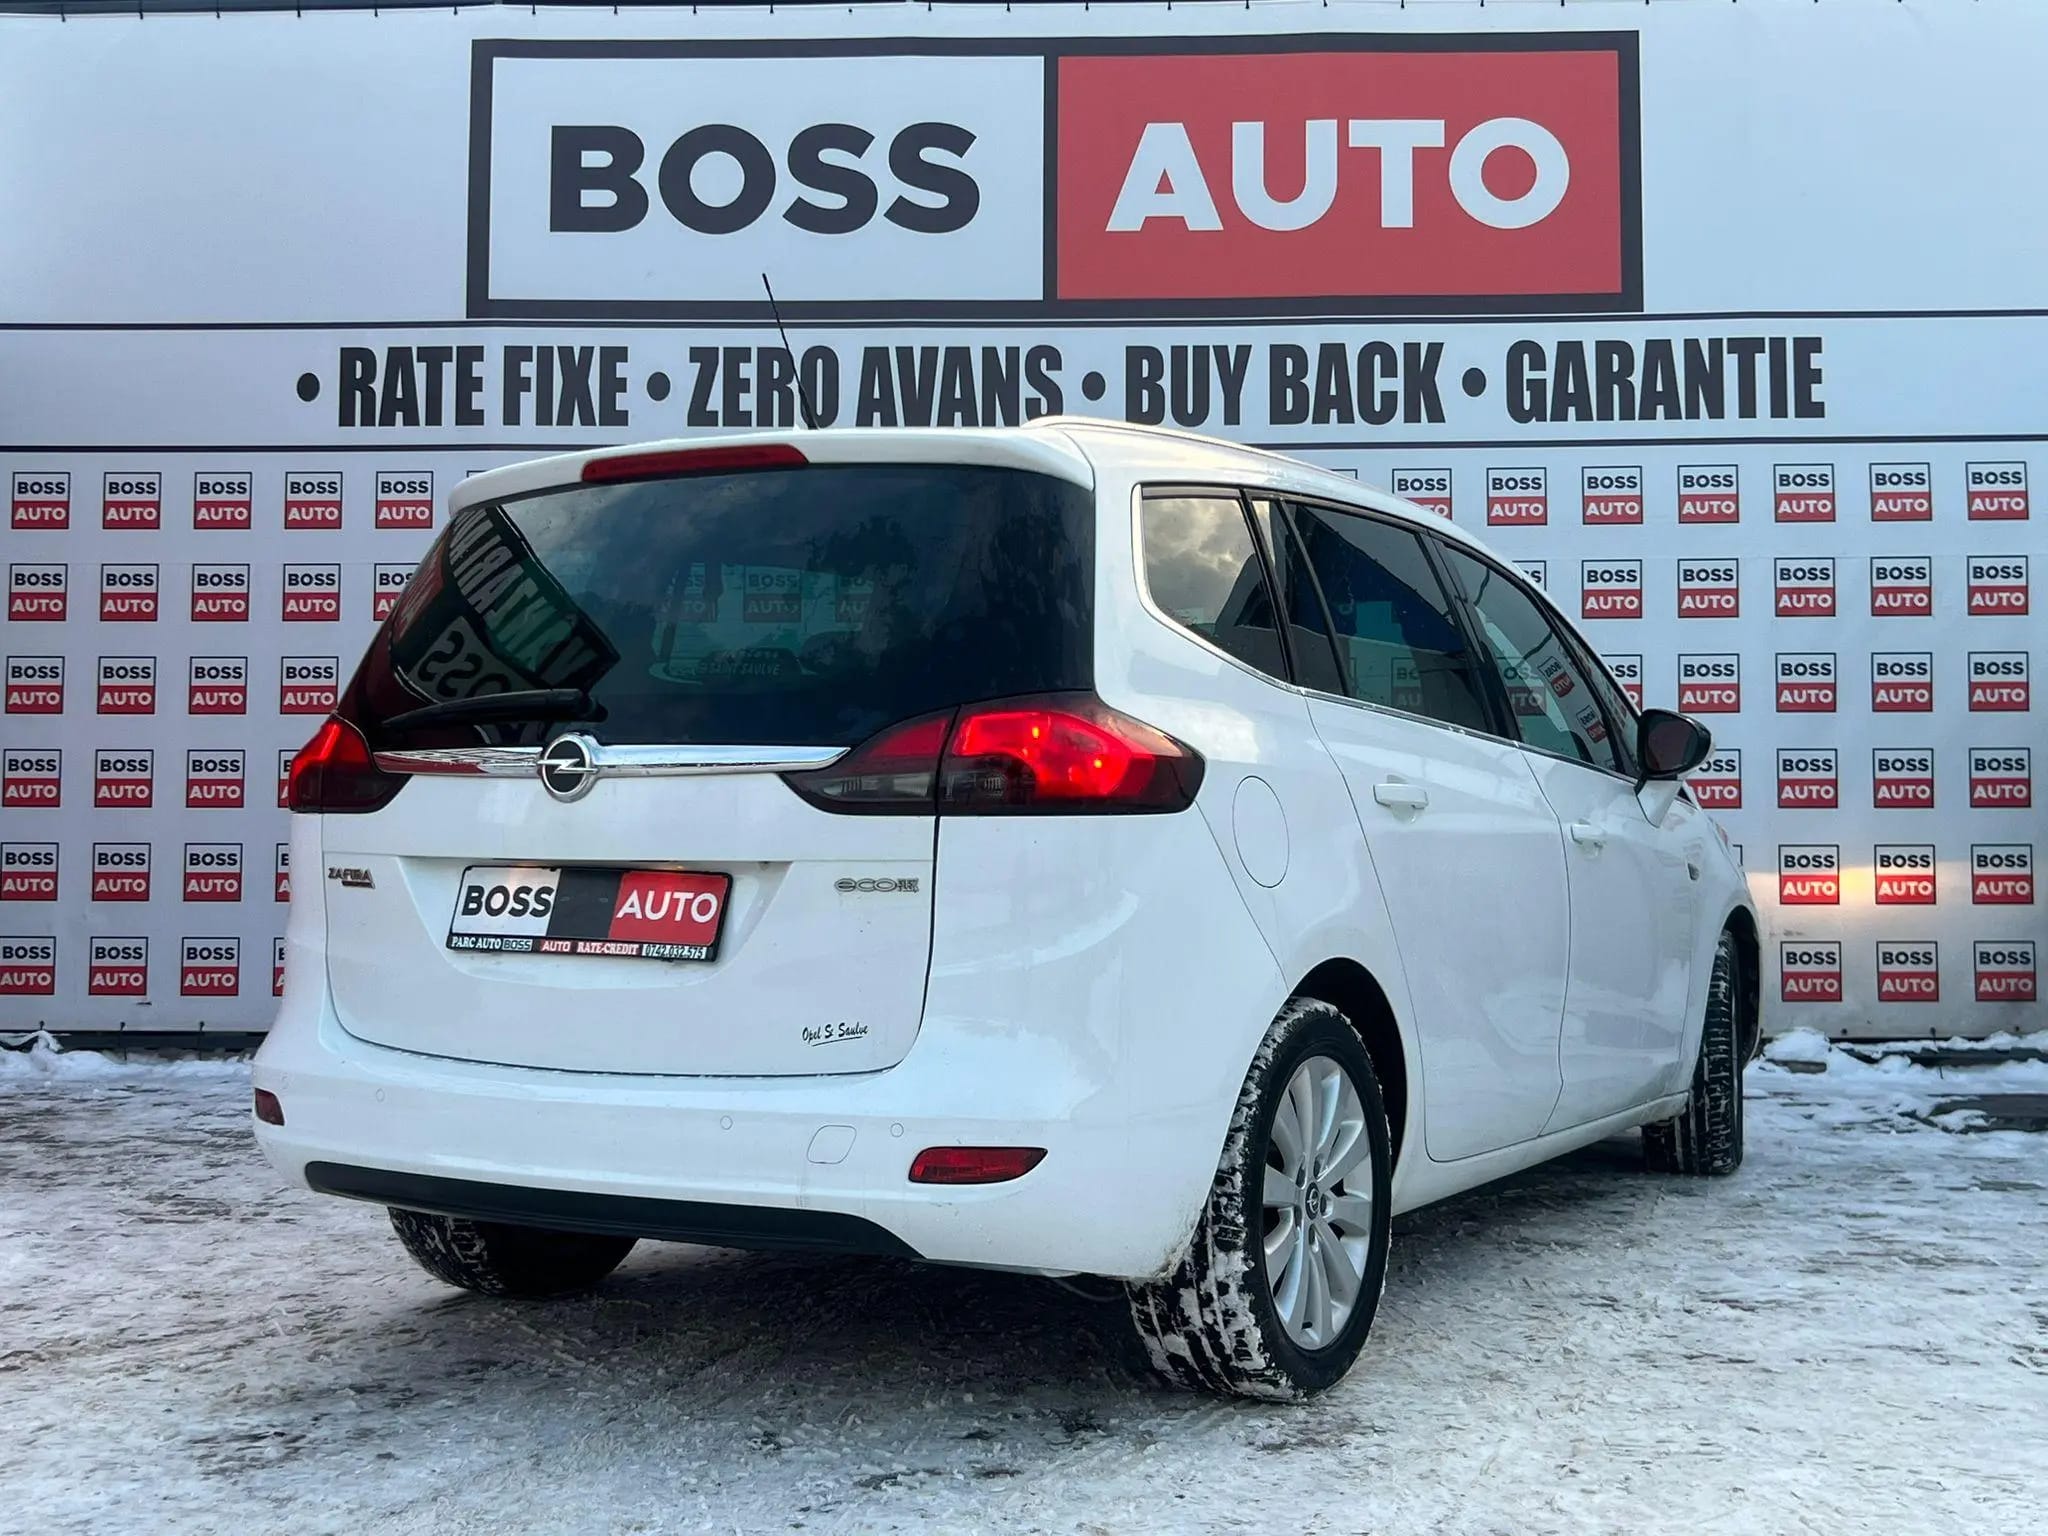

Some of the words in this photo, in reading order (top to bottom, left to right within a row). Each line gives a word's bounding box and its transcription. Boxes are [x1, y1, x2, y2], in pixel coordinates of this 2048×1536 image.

[551, 122, 979, 235] BOSS
[1106, 117, 1570, 232] AUTO
[338, 346, 484, 427] RATE
[503, 346, 628, 427] FIXE
[687, 345, 839, 428] ZERO
[856, 345, 1064, 427] AVANS
[1125, 344, 1252, 427] BUY
[1269, 341, 1445, 425] BACK
[1506, 337, 1825, 424] GARANTIE
[1396, 477, 1448, 492] BOSS
[1491, 476, 1543, 490] BOSS
[1587, 475, 1639, 489] BOSS
[1683, 474, 1734, 488] BOSS
[1779, 473, 1830, 487] BOSS
[1875, 472, 1926, 485] BOSS
[1971, 471, 2023, 484] BOSS
[17, 481, 65, 494] BOSS
[108, 481, 155, 494] BOSS
[199, 481, 246, 494] BOSS
[290, 481, 337, 494] BOSS
[380, 480, 428, 493] BOSS
[1490, 504, 1543, 518] AUTO
[1586, 502, 1639, 516] AUTO
[1682, 501, 1736, 515] AUTO
[1779, 500, 1832, 514] AUTO
[1874, 499, 1928, 513] AUTO
[1971, 497, 2024, 512] AUTO
[15, 507, 66, 521] AUTO
[106, 507, 157, 521] AUTO
[197, 507, 248, 521] AUTO
[288, 506, 339, 521] AUTO
[378, 506, 430, 520] AUTO
[14, 572, 62, 586] BOSS
[106, 573, 153, 586] BOSS
[197, 573, 245, 586] BOSS
[287, 573, 335, 586] BOSS
[1587, 569, 1638, 583] BOSS
[1683, 568, 1734, 582] BOSS
[1779, 567, 1831, 581] BOSS
[1876, 567, 1927, 580] BOSS
[1973, 566, 2024, 579] BOSS
[749, 574, 798, 587] BOSS
[12, 598, 63, 612] AUTO
[104, 599, 155, 613] AUTO
[194, 599, 246, 613] AUTO
[286, 598, 337, 613] AUTO
[1587, 596, 1639, 610] AUTO
[1683, 595, 1736, 609] AUTO
[1779, 594, 1833, 608] AUTO
[1876, 593, 1929, 607] AUTO
[1973, 592, 2026, 607] AUTO
[11, 665, 58, 678] BOSS
[103, 665, 150, 679] BOSS
[194, 666, 242, 679] BOSS
[285, 665, 334, 679] BOSS
[1683, 664, 1736, 678] BOSS
[1781, 663, 1832, 677] BOSS
[1877, 662, 1928, 675] BOSS
[1973, 661, 2025, 675] BOSS
[8, 692, 60, 705] AUTO
[101, 692, 152, 705] AUTO
[192, 692, 244, 706] AUTO
[283, 692, 335, 706] AUTO
[1683, 690, 1737, 704] AUTO
[1780, 690, 1834, 704] AUTO
[1877, 690, 1930, 703] AUTO
[1973, 689, 2026, 703] AUTO
[7, 758, 55, 771] BOSS
[100, 758, 148, 772] BOSS
[191, 759, 239, 772] BOSS
[1698, 759, 1736, 773] OSS
[1782, 758, 1834, 773] BOSS
[1879, 758, 1930, 772] BOSS
[1974, 758, 2026, 772] BOSS
[5, 785, 57, 798] AUTO
[98, 785, 149, 799] AUTO
[189, 785, 241, 799] AUTO
[1697, 785, 1738, 800] UTO
[1782, 786, 1835, 800] AUTO
[1878, 786, 1931, 799] AUTO
[1974, 785, 2027, 799] AUTO
[5, 852, 53, 865] BOSS
[97, 852, 145, 865] BOSS
[189, 852, 237, 866] BOSS
[1784, 854, 1836, 868] BOSS
[1880, 854, 1932, 868] BOSS
[1977, 854, 2029, 868] BOSS
[328, 867, 373, 882] ZAFIRA
[3, 878, 54, 892] AUTO
[95, 879, 146, 892] AUTO
[187, 879, 238, 893] AUTO
[1782, 881, 1836, 896] AUTO
[1878, 881, 1932, 896] AUTO
[1976, 882, 2030, 895] AUTO
[461, 885, 555, 917] BOSS
[616, 890, 719, 923] AUTO
[2, 945, 50, 959] BOSS
[94, 946, 141, 959] BOSS
[186, 946, 233, 960] BOSS
[451, 936, 477, 949] PARC
[476, 937, 501, 950] AUTO
[503, 939, 531, 951] BOSS
[542, 940, 571, 953] AUTO
[577, 942, 639, 956] RATE-CREDIT
[1787, 952, 1837, 966] BOSS
[1883, 952, 1934, 966] BOSS
[1979, 951, 2031, 965] BOSS
[1, 972, 51, 986] AUTO
[92, 973, 143, 986] AUTO
[184, 973, 235, 987] AUTO
[1786, 979, 1838, 993] AUTO
[1883, 979, 1935, 993] AUTO
[1979, 979, 2032, 992] AUTO
